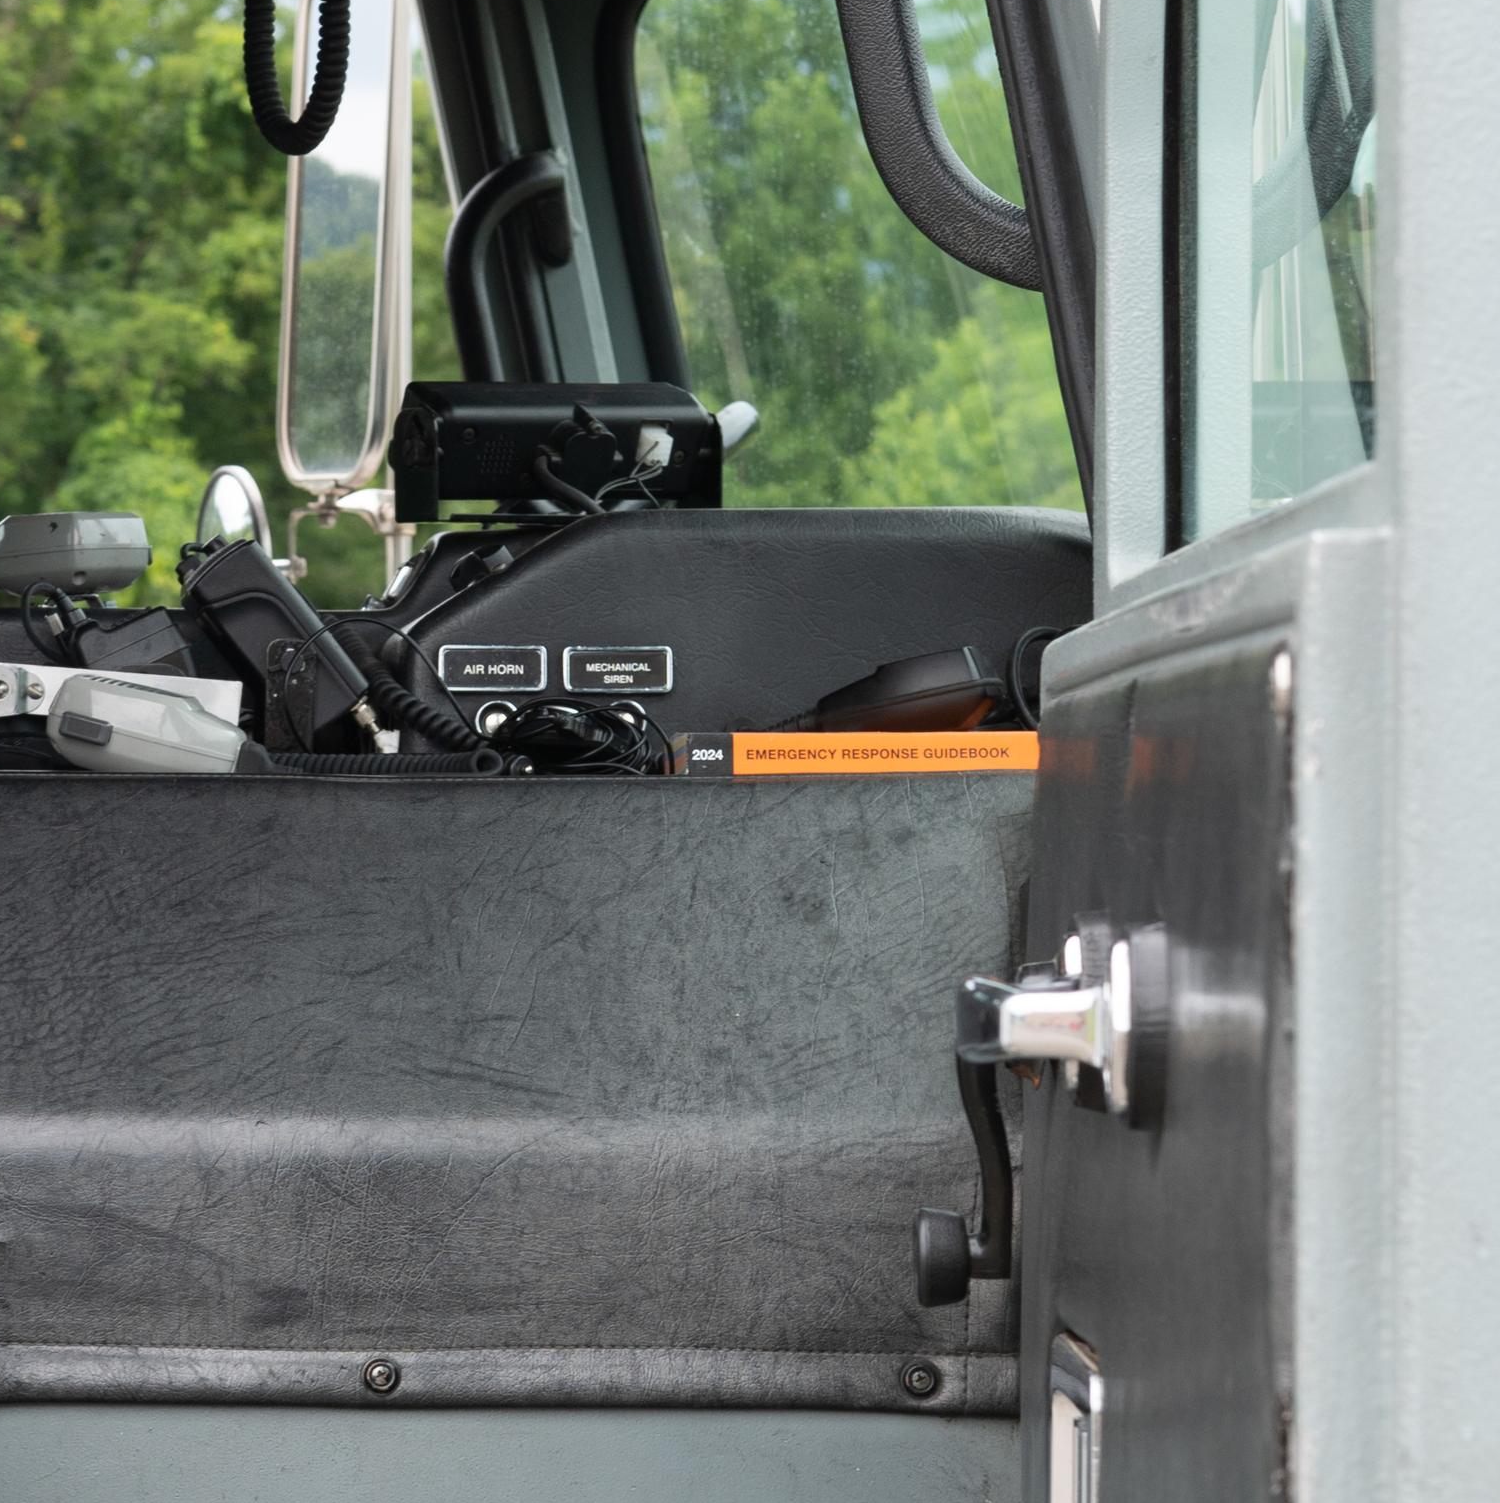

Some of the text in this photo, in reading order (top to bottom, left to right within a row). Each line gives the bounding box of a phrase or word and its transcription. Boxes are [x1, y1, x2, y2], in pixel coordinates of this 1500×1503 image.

[463, 664, 524, 675] AIR HORN
[585, 663, 651, 672] MECHANICAL
[603, 674, 634, 684] SIREN
[691, 747, 1010, 761] 2024 EMERGENCY RESPONSE GUIDEBOOK
